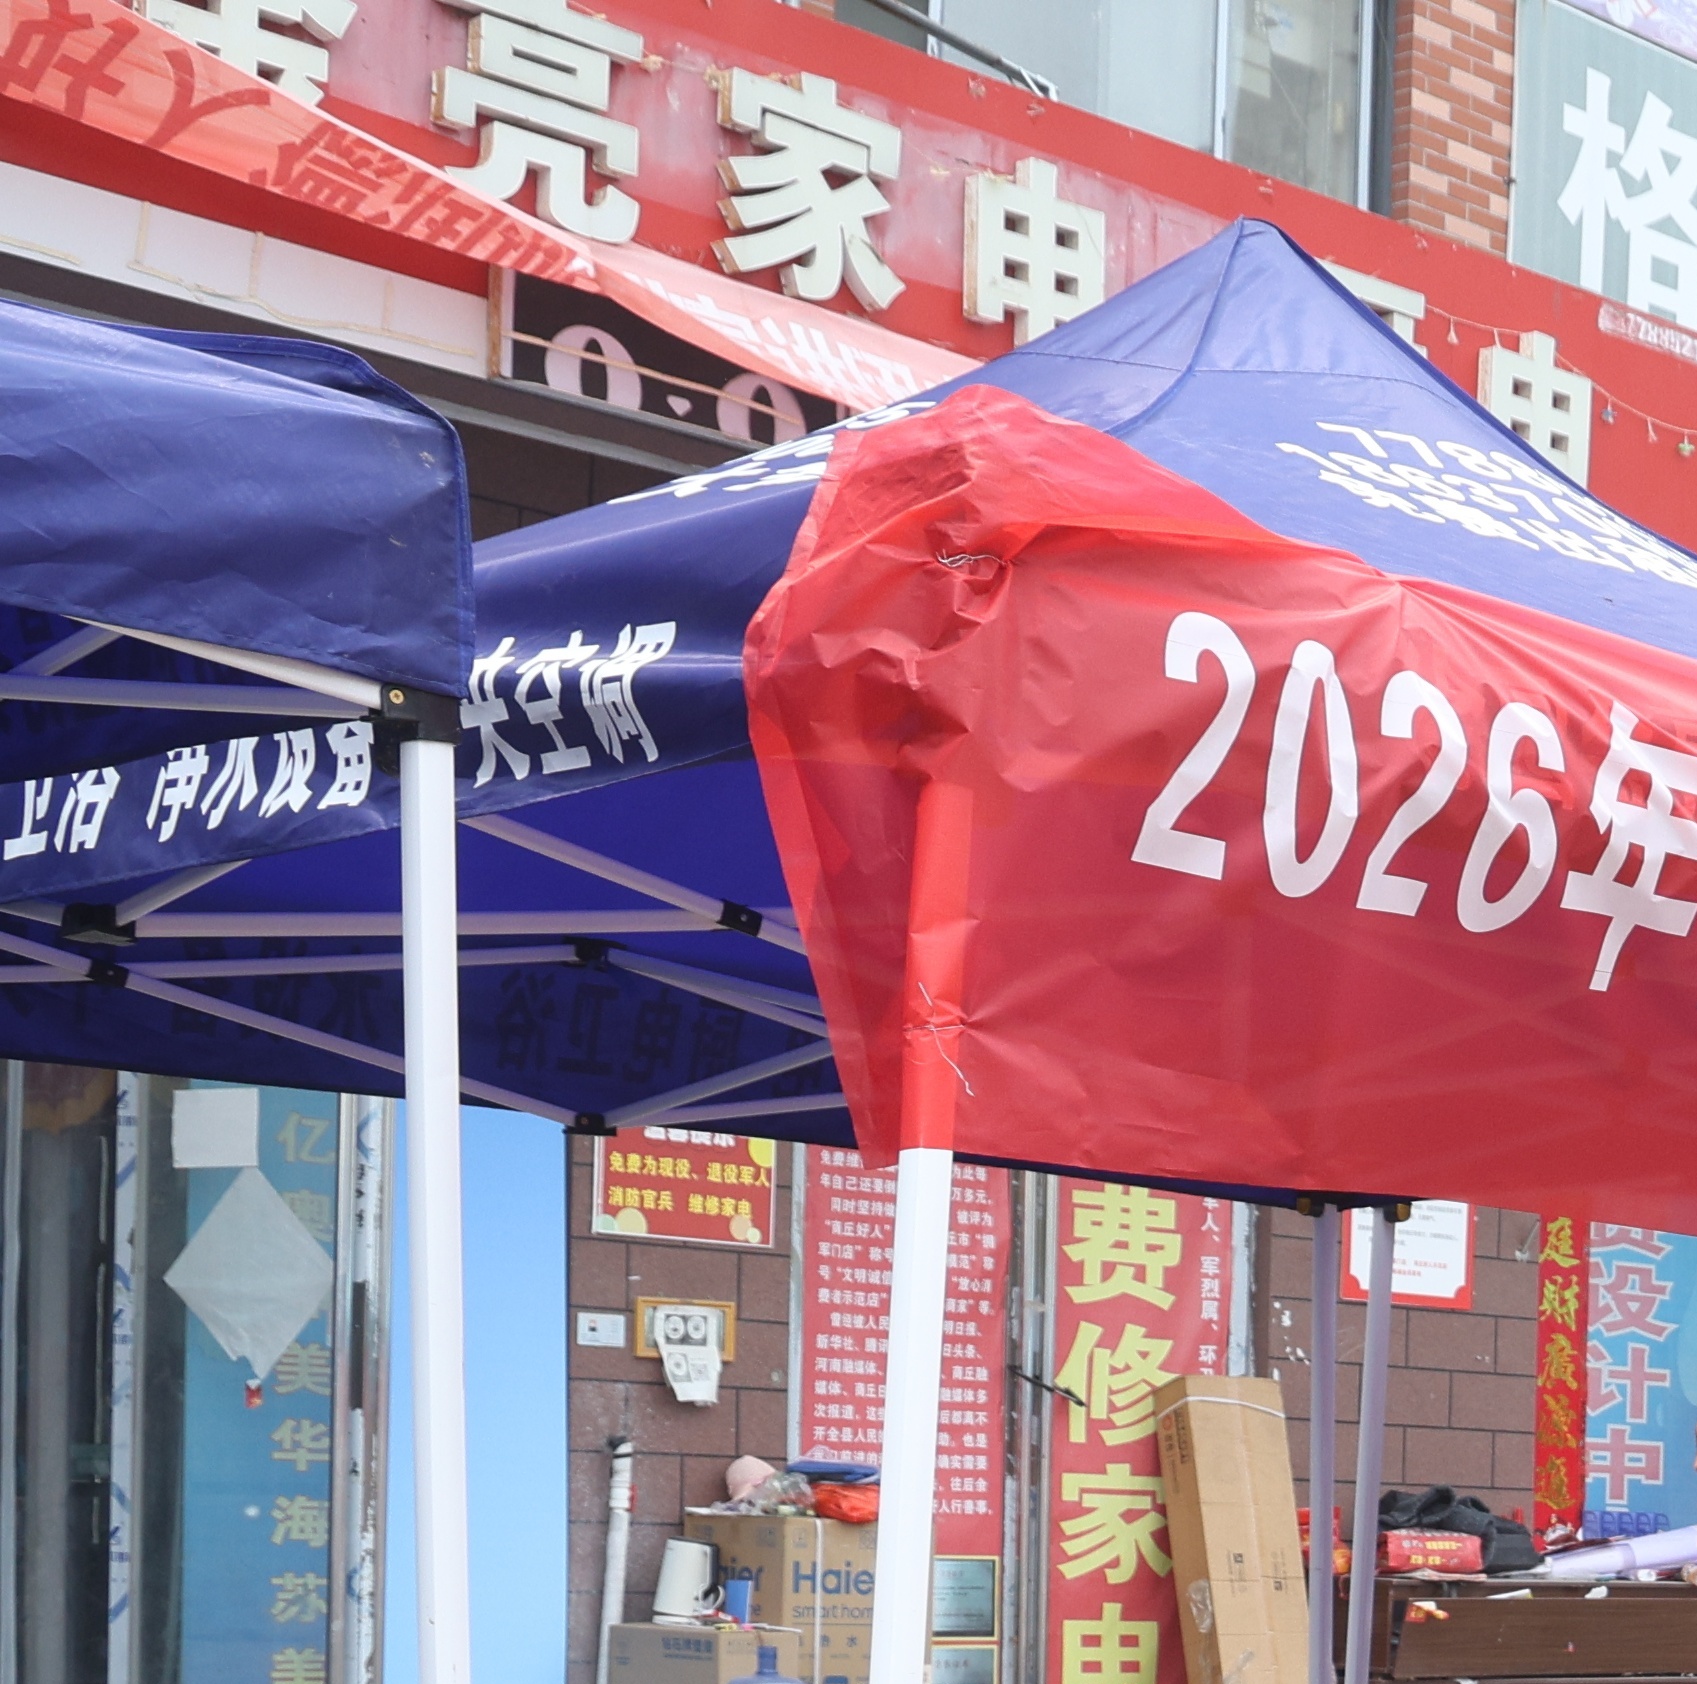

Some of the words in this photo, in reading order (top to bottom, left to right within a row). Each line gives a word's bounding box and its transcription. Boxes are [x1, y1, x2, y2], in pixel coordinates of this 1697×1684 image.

[460, 620, 676, 788] 央空调
[608, 1186, 675, 1212] 消防官兵
[688, 1193, 752, 1218] 维修家电
